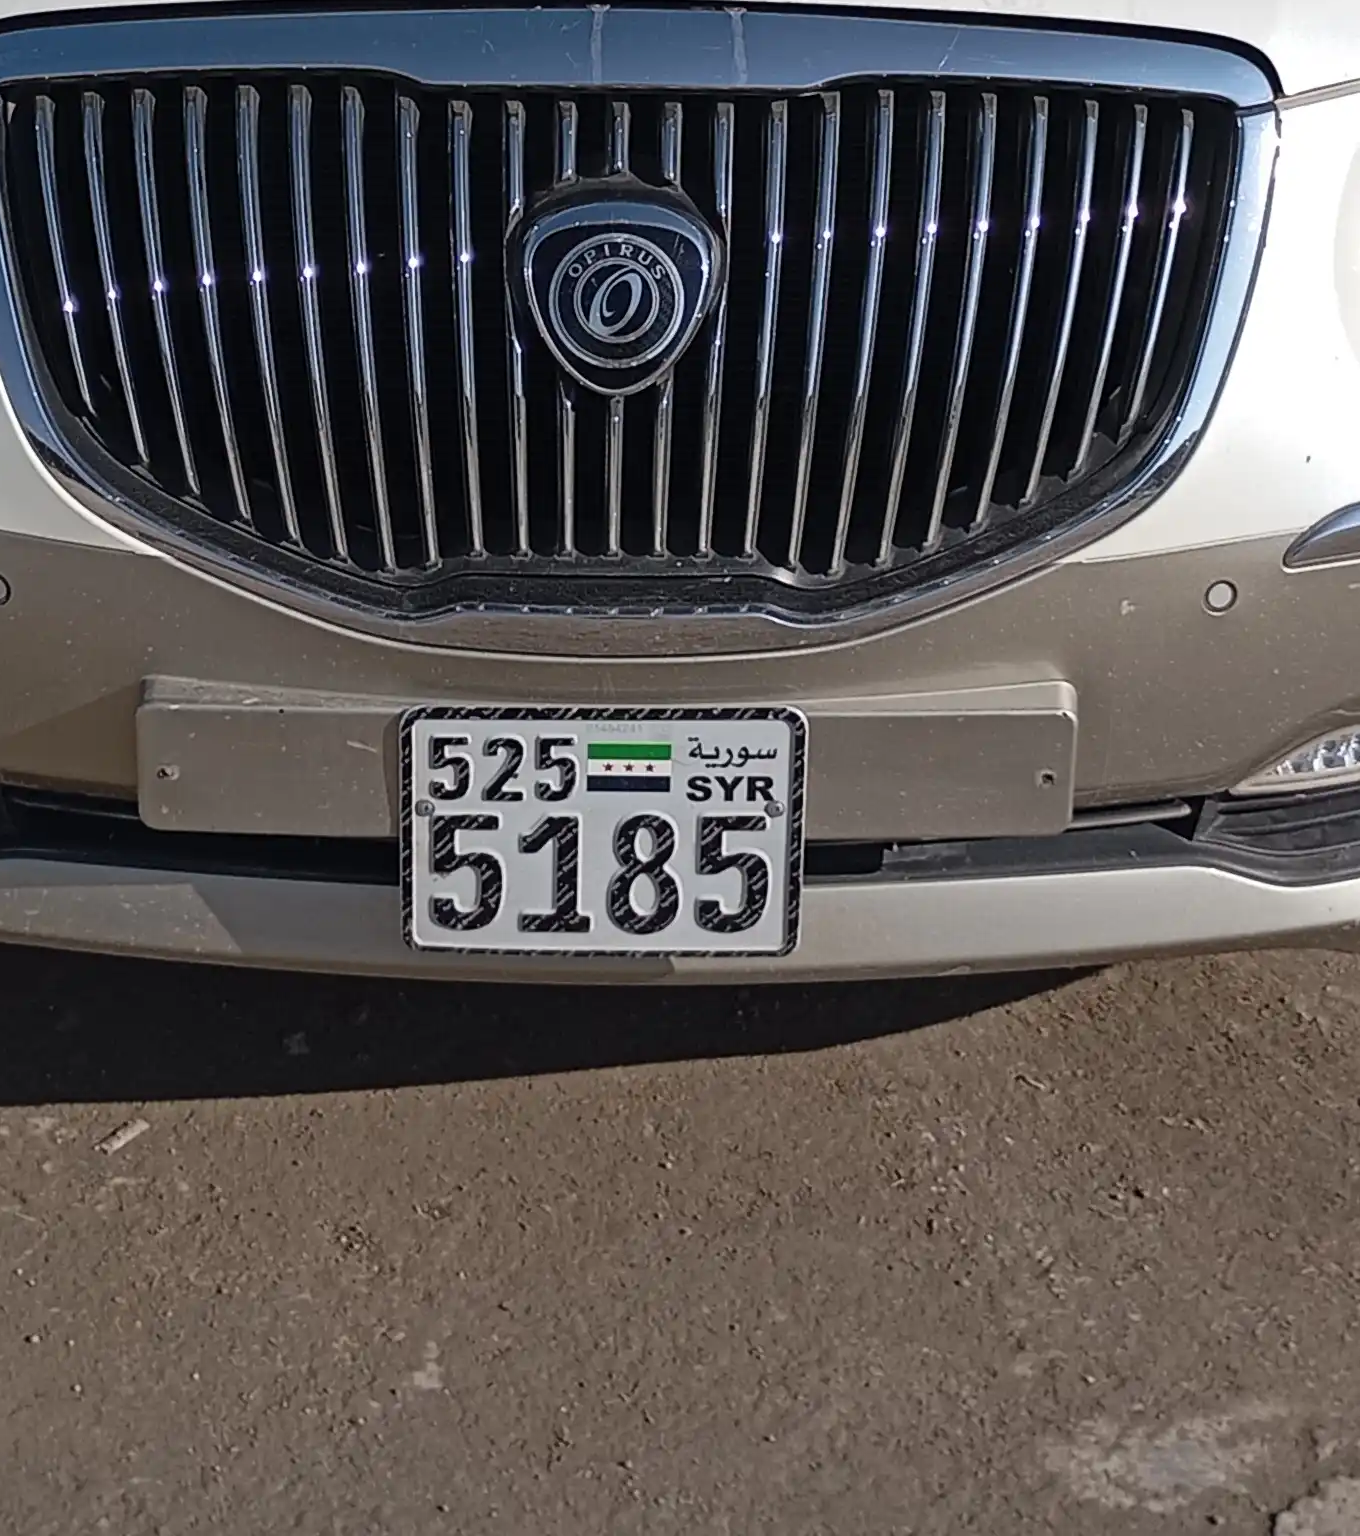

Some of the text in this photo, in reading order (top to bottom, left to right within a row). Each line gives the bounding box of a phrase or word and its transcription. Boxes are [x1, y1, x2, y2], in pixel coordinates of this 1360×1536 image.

[568, 244, 667, 280] OPIRUS
[428, 736, 578, 801] 525
[687, 736, 778, 768] سورية
[686, 775, 775, 802] SYR
[429, 814, 773, 934] 5185
